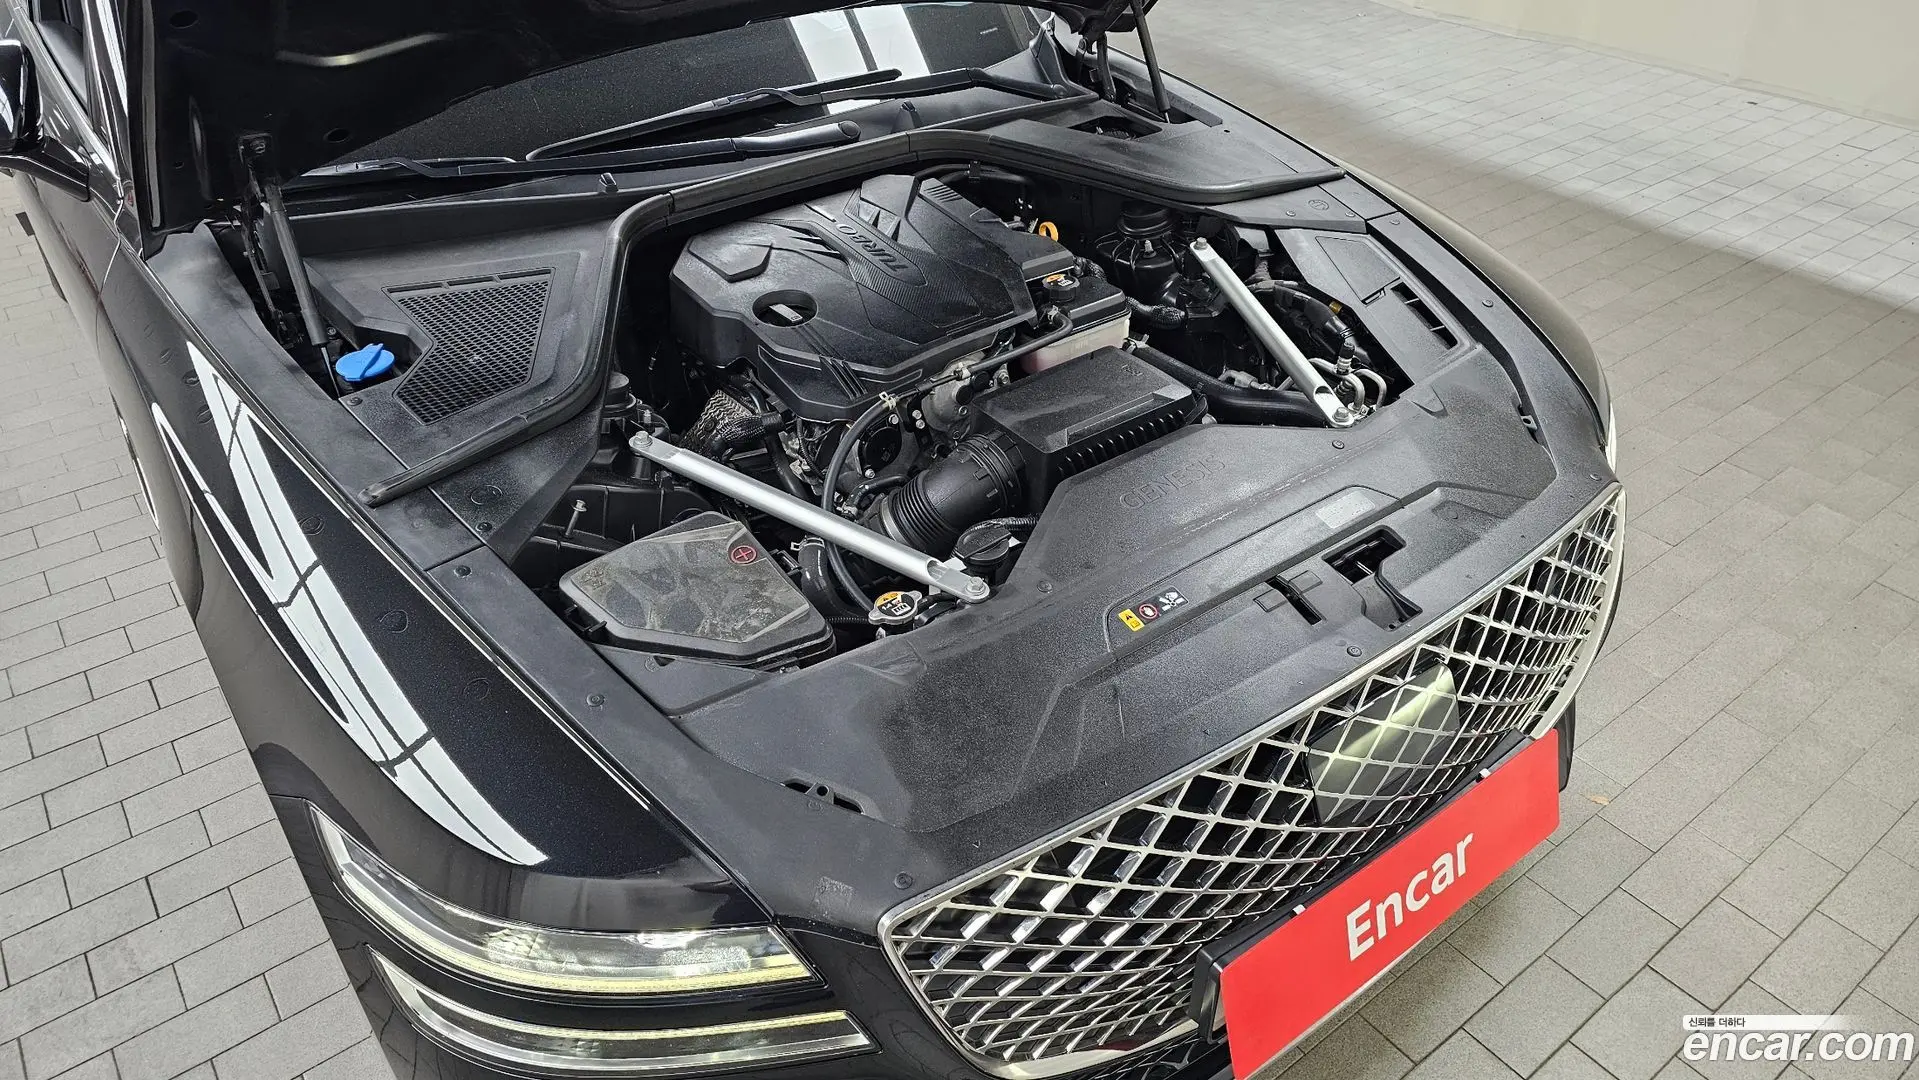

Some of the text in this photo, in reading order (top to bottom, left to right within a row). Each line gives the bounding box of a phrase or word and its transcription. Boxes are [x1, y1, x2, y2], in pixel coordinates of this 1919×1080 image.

[836, 223, 909, 272] TURBO
[1119, 455, 1225, 509] GENESIS
[1346, 832, 1474, 962] Encar
